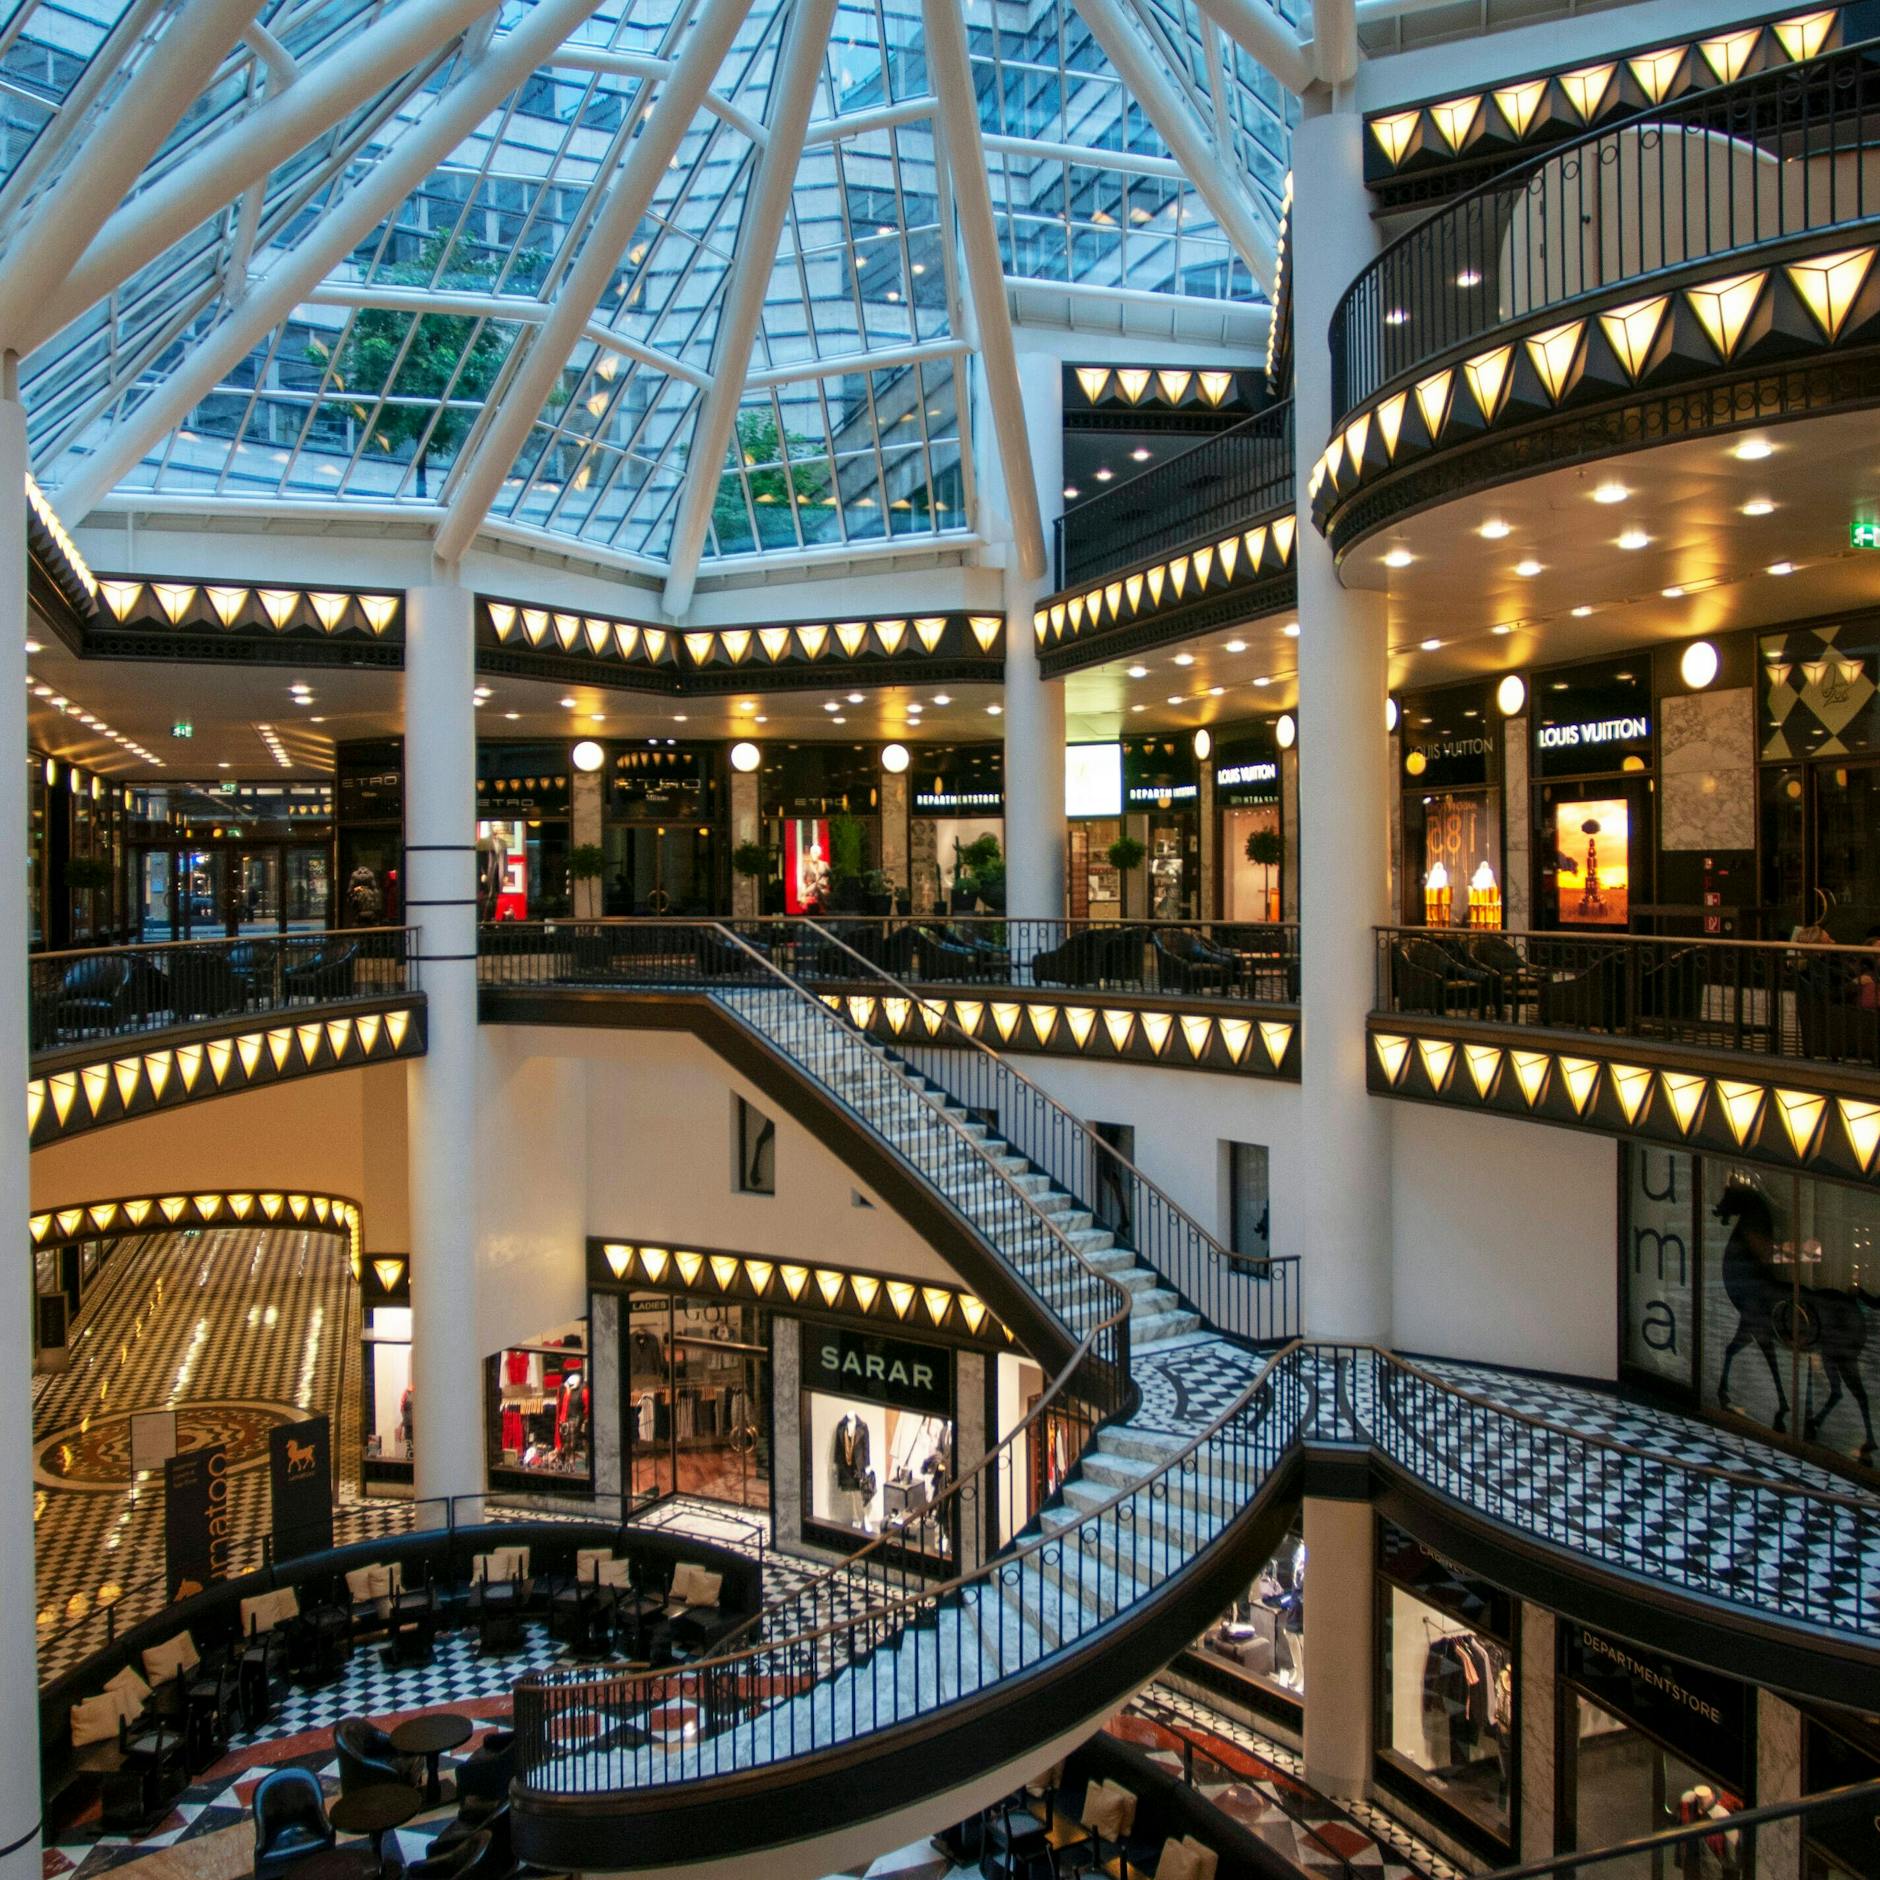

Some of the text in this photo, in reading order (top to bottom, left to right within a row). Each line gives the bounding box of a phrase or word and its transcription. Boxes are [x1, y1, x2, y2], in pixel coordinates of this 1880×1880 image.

[1539, 717, 1647, 749] LOUIS VUITTON
[342, 775, 398, 789] ETRO
[479, 798, 535, 807] ETRO
[1634, 1149, 1686, 1356] uma
[631, 1300, 668, 1312] LADIES
[820, 1345, 934, 1391] SARAR
[1582, 1630, 1723, 1726] DEPARTMENTSTORE
